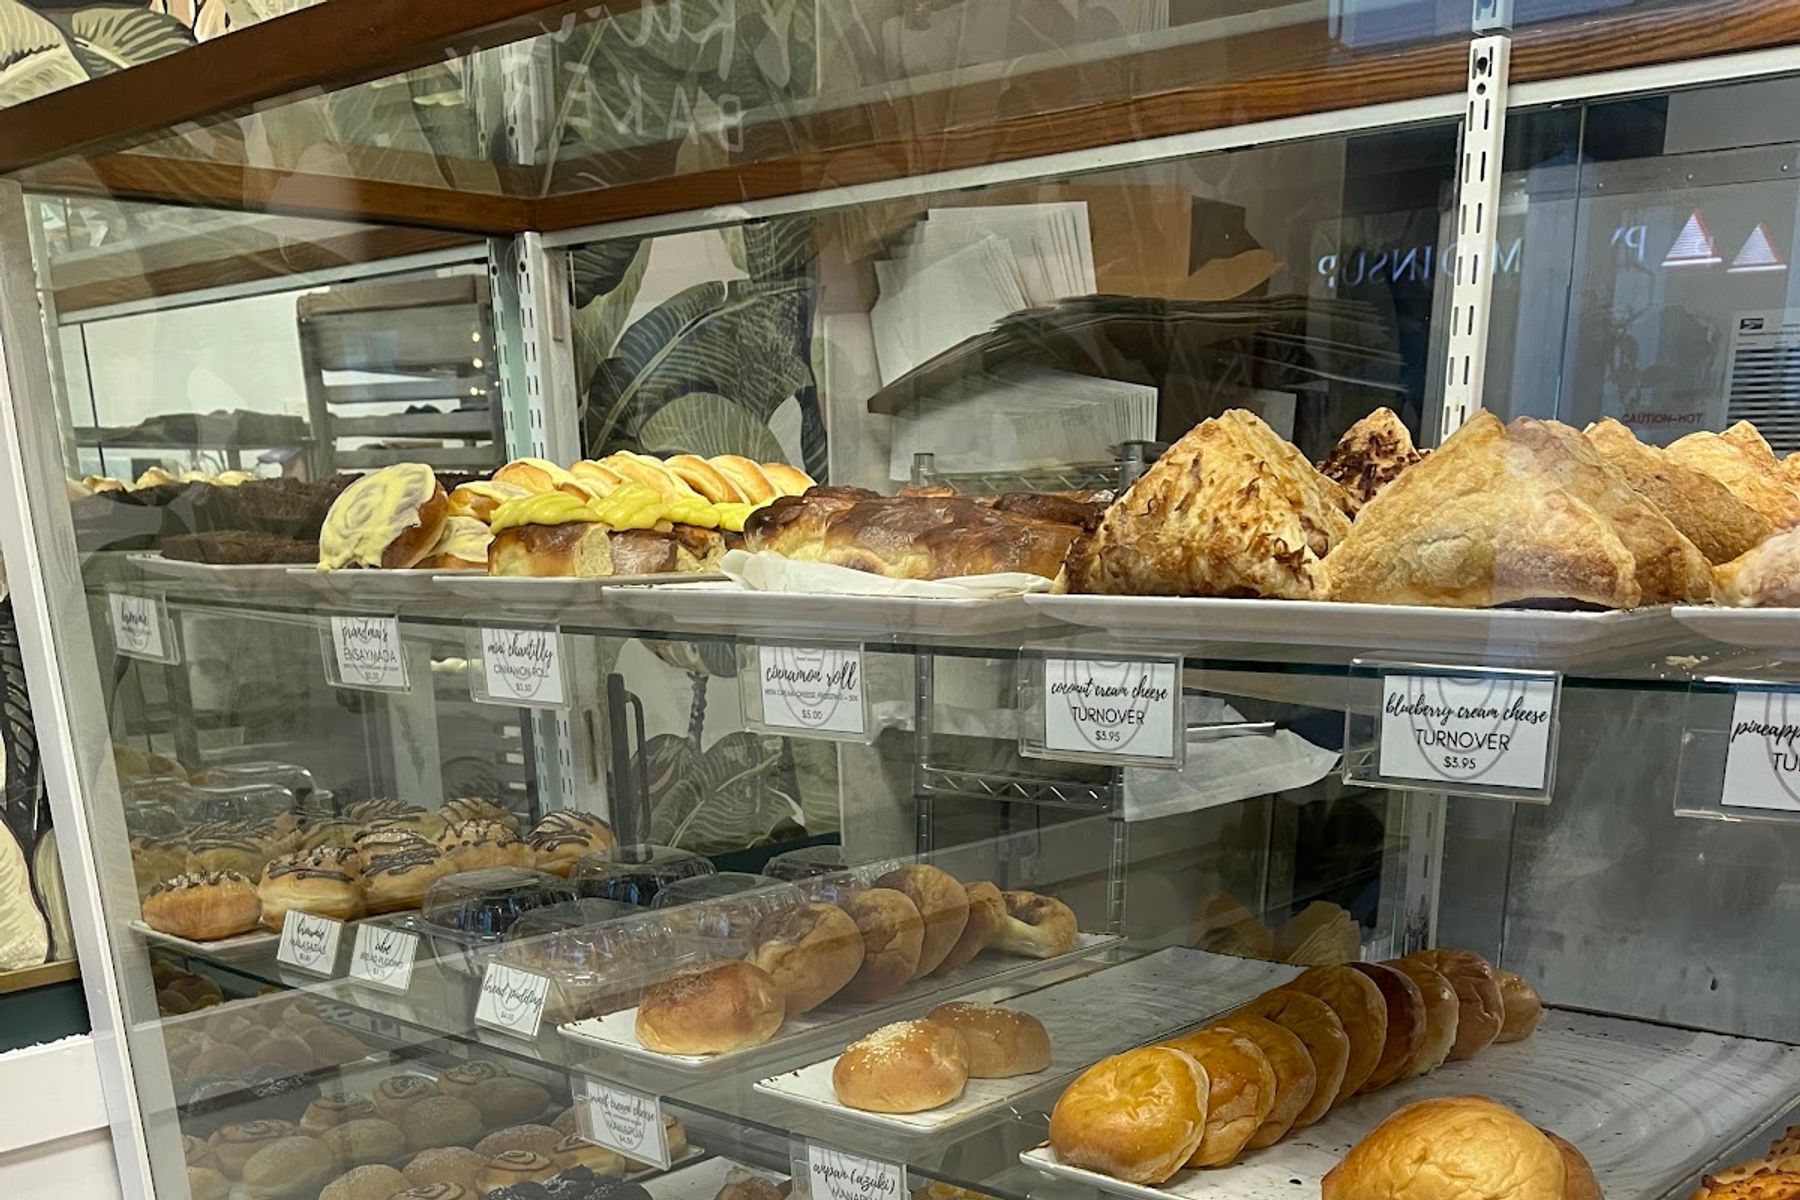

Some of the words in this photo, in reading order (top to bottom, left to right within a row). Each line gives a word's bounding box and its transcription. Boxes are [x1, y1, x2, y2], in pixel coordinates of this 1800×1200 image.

[766, 664, 822, 682] cinnamon
[827, 661, 857, 690] roll
[1051, 678, 1094, 697] coconut
[1094, 685, 1129, 697] cream
[1132, 675, 1168, 701] cheese
[801, 709, 822, 720] $5.00
[1071, 706, 1144, 725] TURNOVER
[1385, 692, 1453, 725] blueberry
[1457, 706, 1499, 719] cream
[1502, 696, 1548, 724] cheese
[1095, 730, 1121, 742] $3.95
[1416, 729, 1510, 751] TURNOVER
[1443, 756, 1476, 770] $3.95
[483, 974, 509, 997] bread
[506, 988, 542, 1014] pudding
[851, 1169, 896, 1195] (azuki)
